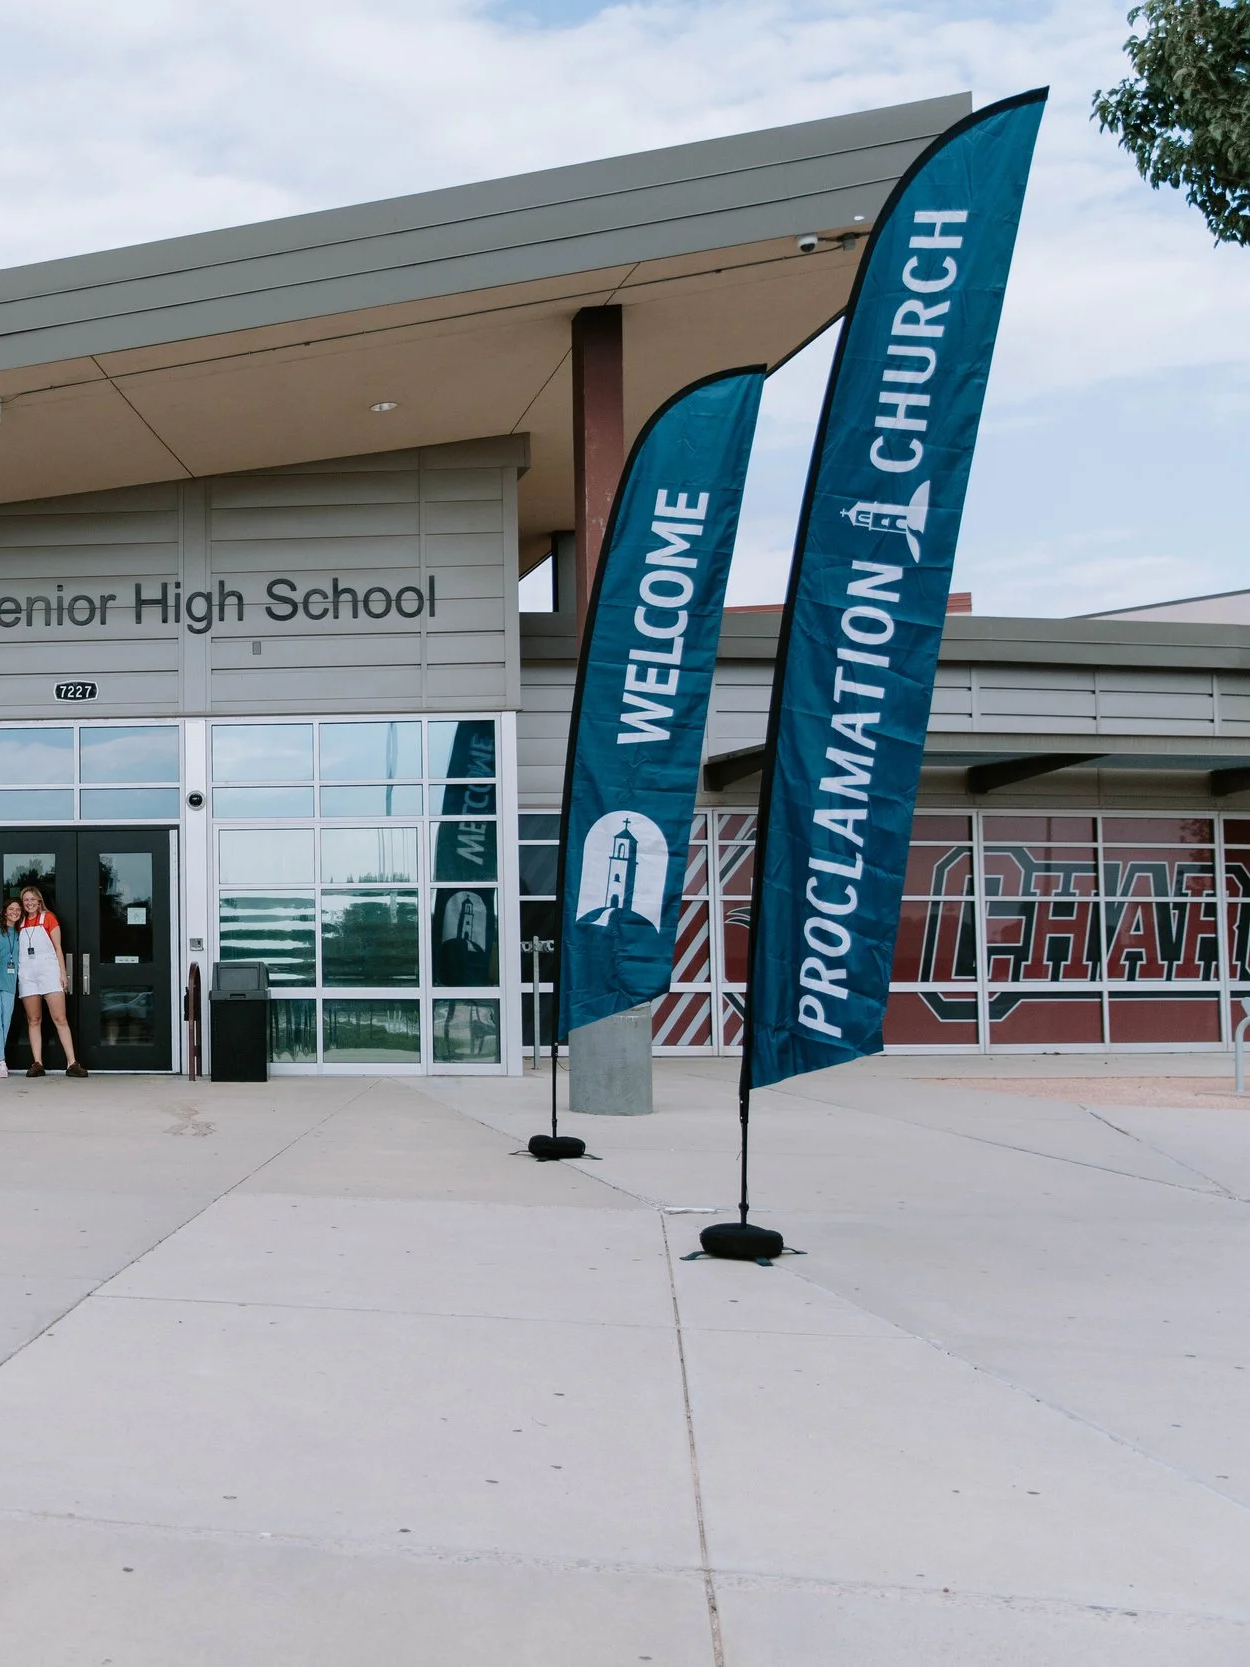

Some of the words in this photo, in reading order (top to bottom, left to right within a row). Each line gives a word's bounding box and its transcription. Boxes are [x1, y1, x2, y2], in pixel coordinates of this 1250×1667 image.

[59, 685, 92, 698] 7227
[134, 579, 244, 635] High
[265, 575, 436, 622] School
[617, 489, 710, 745] WELCOME
[798, 560, 904, 1038] PROCLAMATION
[869, 210, 968, 474] CHURCH
[918, 846, 1250, 1022] CHAR
